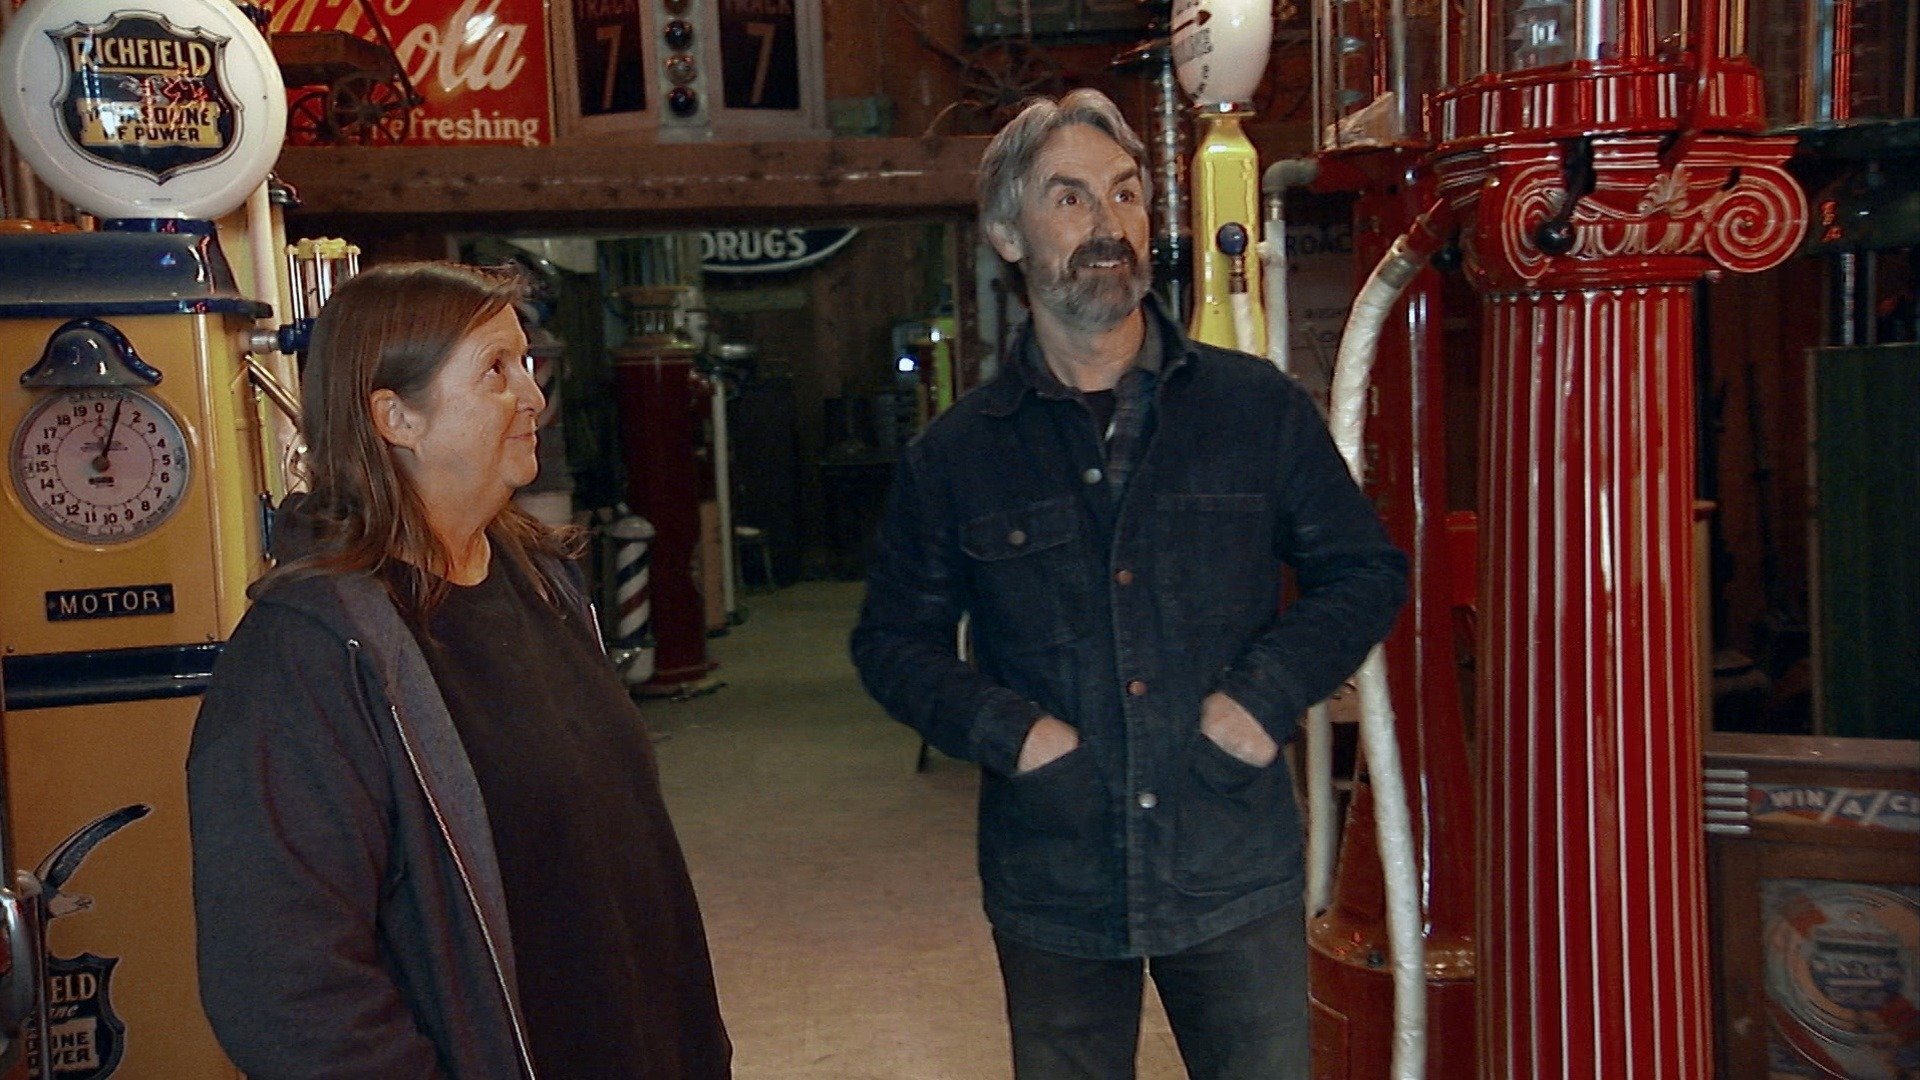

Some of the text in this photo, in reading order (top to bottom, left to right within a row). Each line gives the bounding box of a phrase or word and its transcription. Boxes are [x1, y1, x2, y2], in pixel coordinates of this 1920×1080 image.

[71, 37, 212, 77] RICHFIELD
[744, 21, 777, 104] 7
[595, 25, 621, 110] 7
[134, 126, 200, 141] POWER
[700, 229, 807, 260] DRUGS
[73, 405, 87, 417] 19
[95, 402, 104, 413] 0
[57, 414, 71, 426] 18
[132, 411, 141, 423] 2
[43, 428, 57, 439] 17
[147, 422, 156, 434] 3
[157, 438, 166, 448] 4
[36, 444, 50, 455] 16
[36, 461, 49, 472] 15
[162, 455, 171, 466] 5
[160, 472, 169, 483] 6
[41, 479, 55, 490] 14
[153, 487, 163, 498] 7
[51, 493, 65, 505] 13
[66, 504, 80, 516] 12
[141, 500, 150, 511] 8
[84, 510, 97, 523] 11
[103, 512, 118, 525] 10
[125, 509, 134, 520] 9
[60, 590, 160, 614] MOTOR
